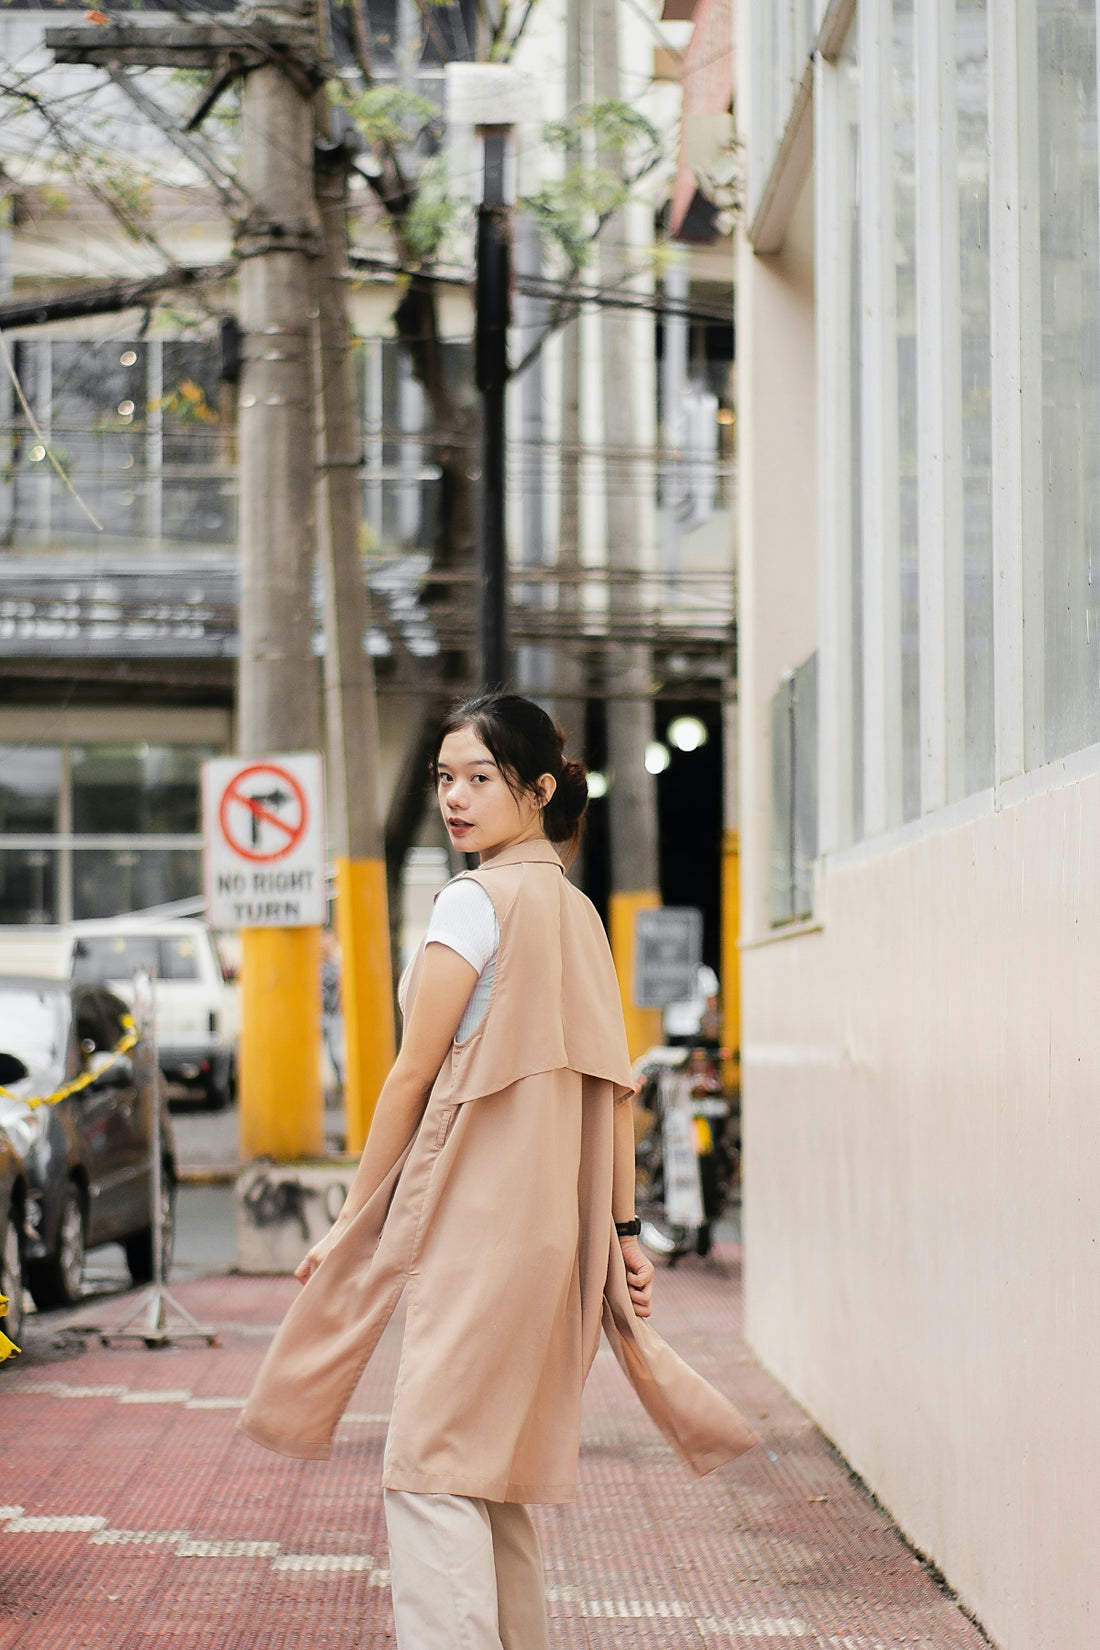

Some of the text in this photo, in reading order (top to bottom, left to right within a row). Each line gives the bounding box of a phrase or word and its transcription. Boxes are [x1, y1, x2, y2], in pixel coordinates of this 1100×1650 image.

[217, 870, 313, 895] NO RIGHT
[233, 902, 299, 921] TURN
